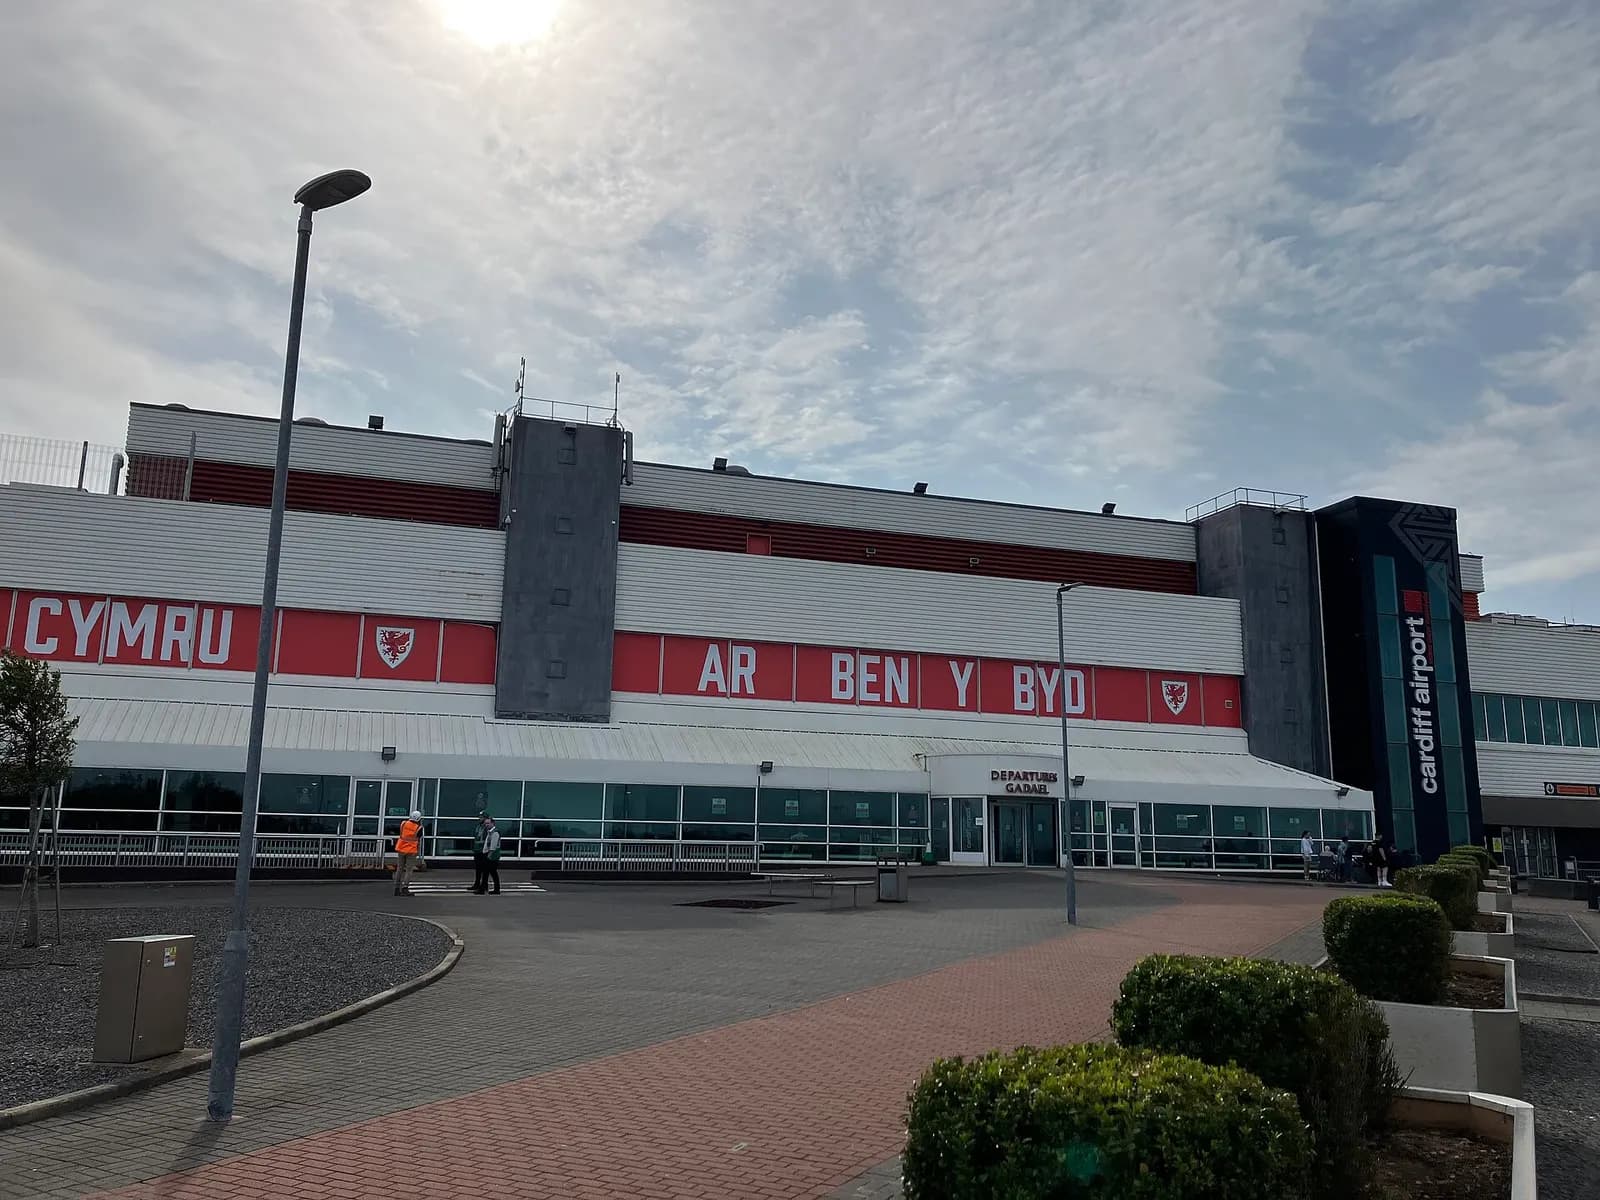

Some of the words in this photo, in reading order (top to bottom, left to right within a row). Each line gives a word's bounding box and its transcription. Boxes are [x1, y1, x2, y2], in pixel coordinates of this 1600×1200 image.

[24, 597, 233, 664] CYMRU
[697, 643, 757, 695] AR
[831, 652, 910, 704] BEN
[949, 660, 975, 707] Y
[1013, 665, 1086, 714] BYD
[1405, 616, 1434, 704] airport
[991, 770, 1058, 782] DEPARTURES
[1006, 783, 1050, 795] GADAEL
[1412, 707, 1438, 794] cardiff
